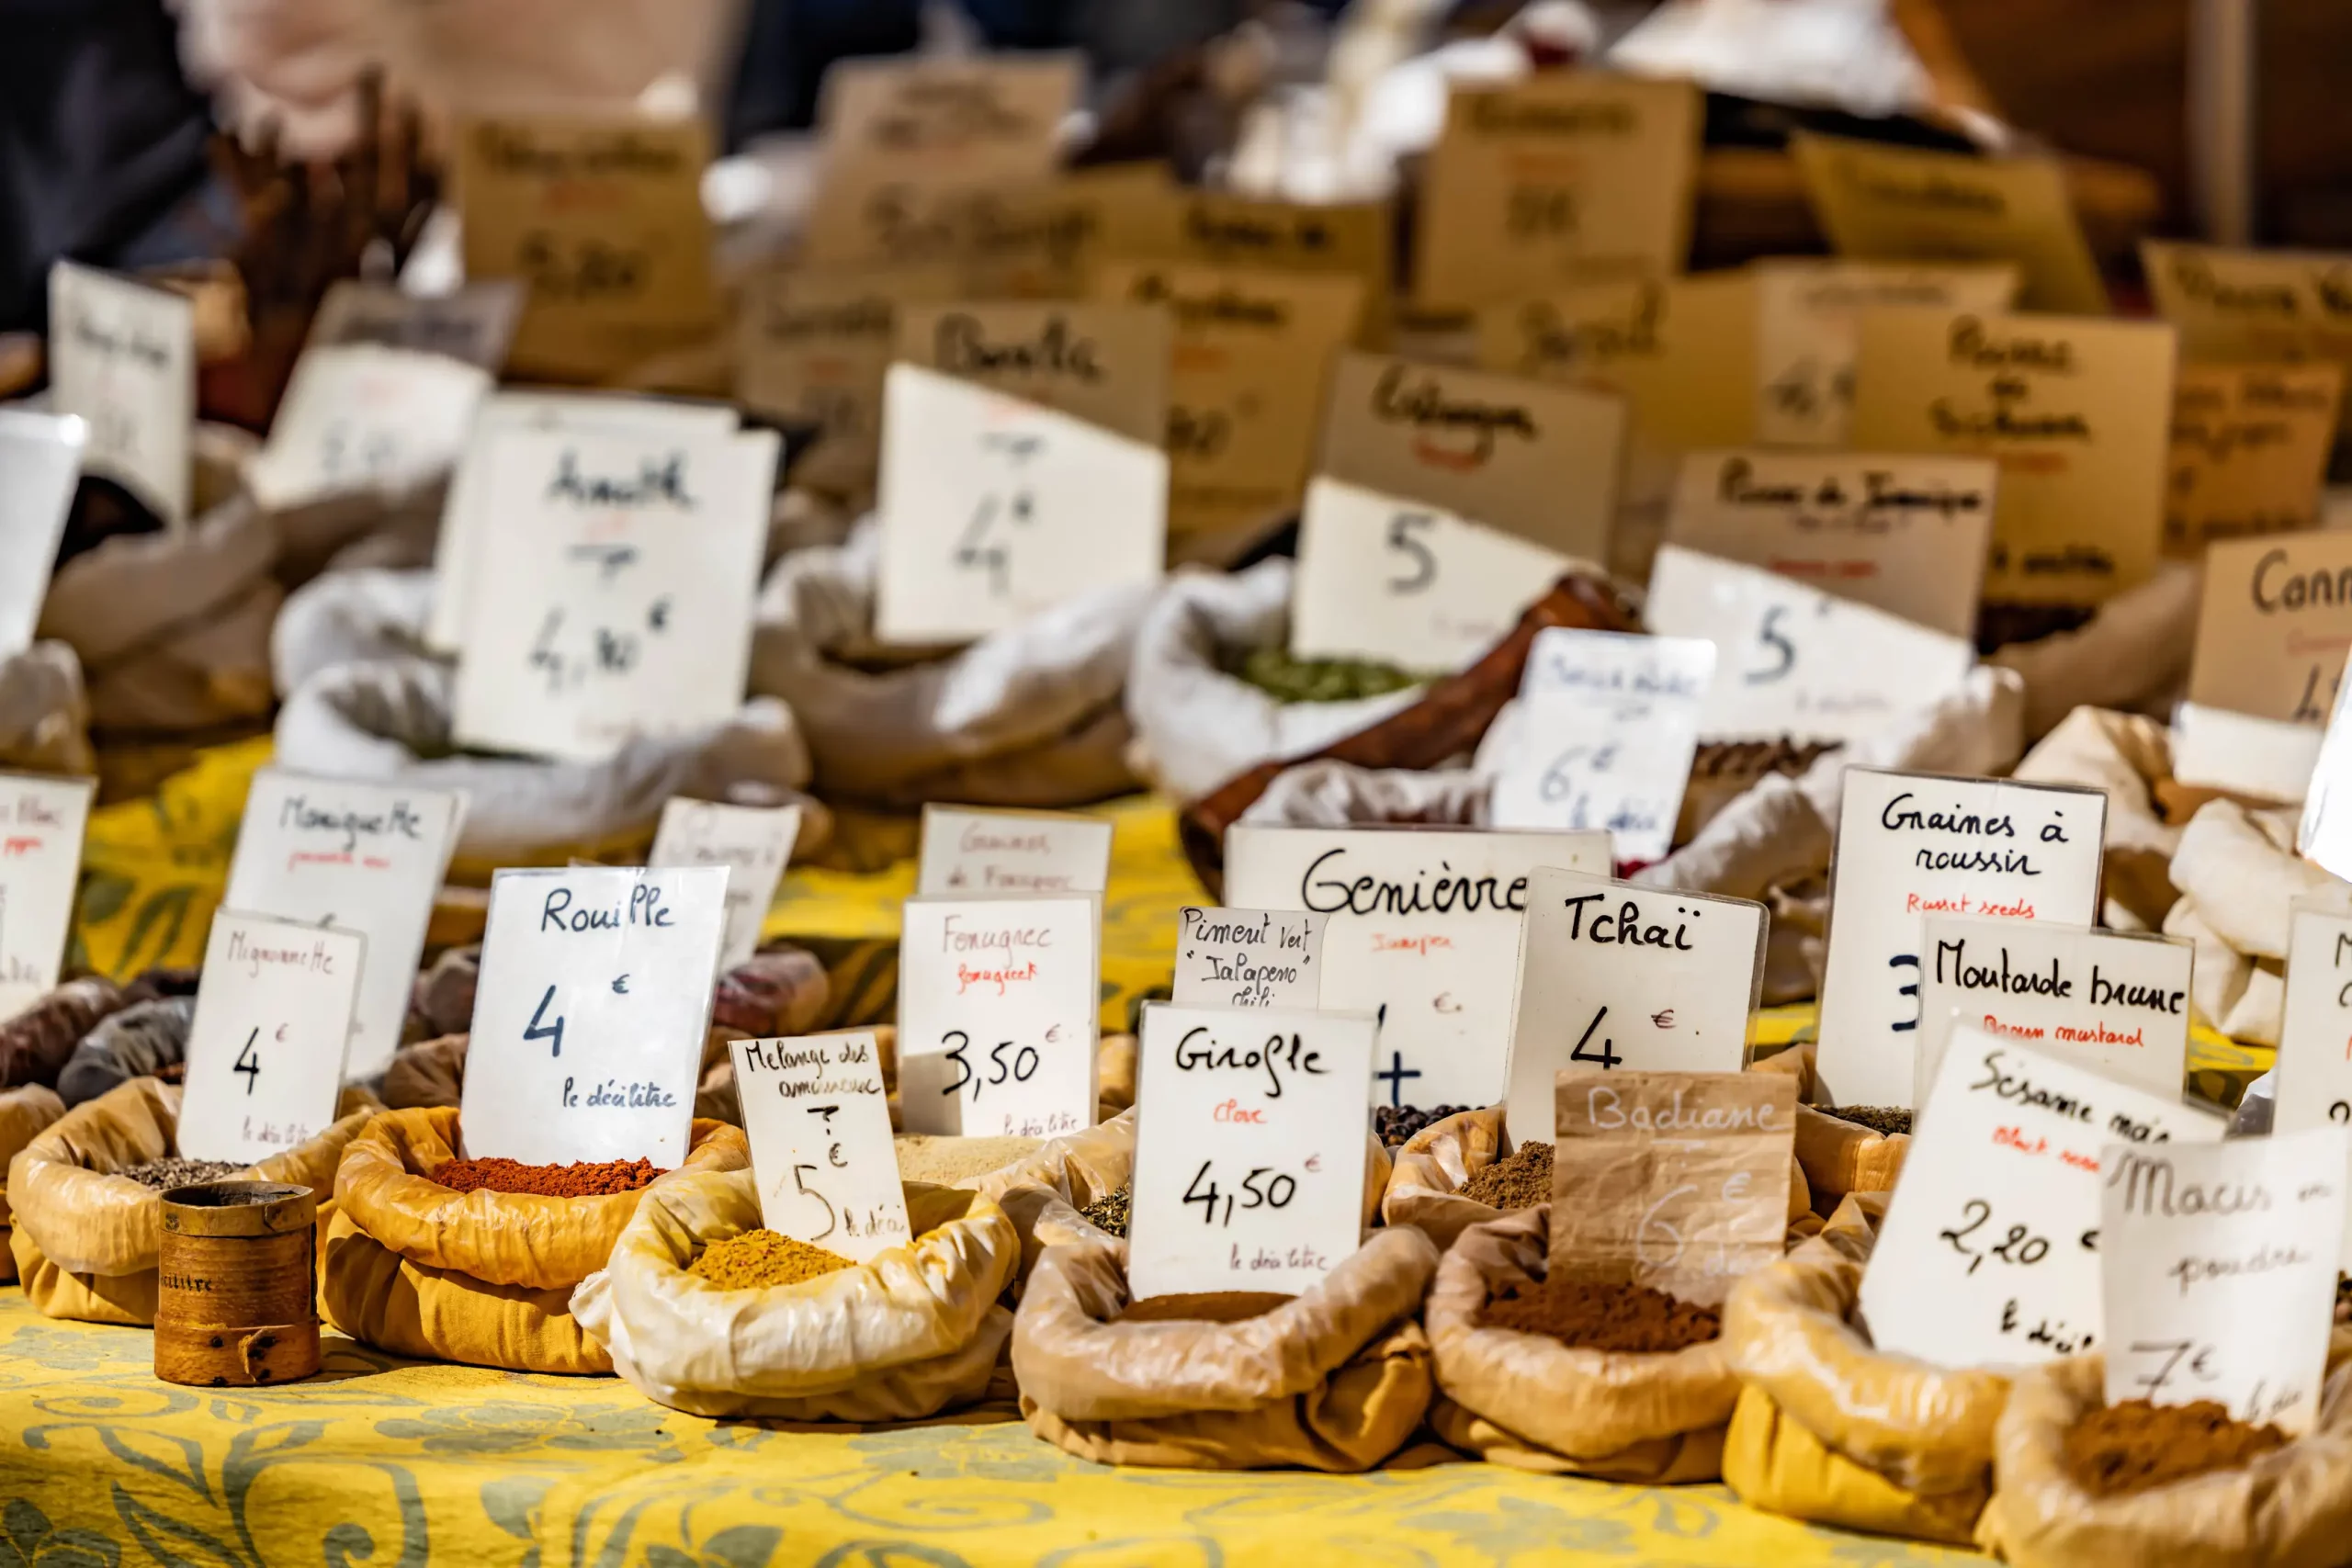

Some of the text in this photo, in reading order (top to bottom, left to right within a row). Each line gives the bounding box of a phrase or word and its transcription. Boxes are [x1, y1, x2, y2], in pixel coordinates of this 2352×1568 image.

[540, 884, 675, 932] Rouille
[1301, 848, 1529, 917] Genièvre
[1565, 891, 1702, 952] Tchaï
[1937, 939, 2186, 1014] Moutarde brune
[524, 985, 564, 1058] 4
[1571, 1006, 1623, 1069] 4
[2054, 1021, 2144, 1047] mustard
[233, 1026, 260, 1097] 4
[1175, 1026, 1330, 1099] Girofle
[1589, 1086, 1787, 1131] Badiane
[793, 1165, 836, 1241] 5
